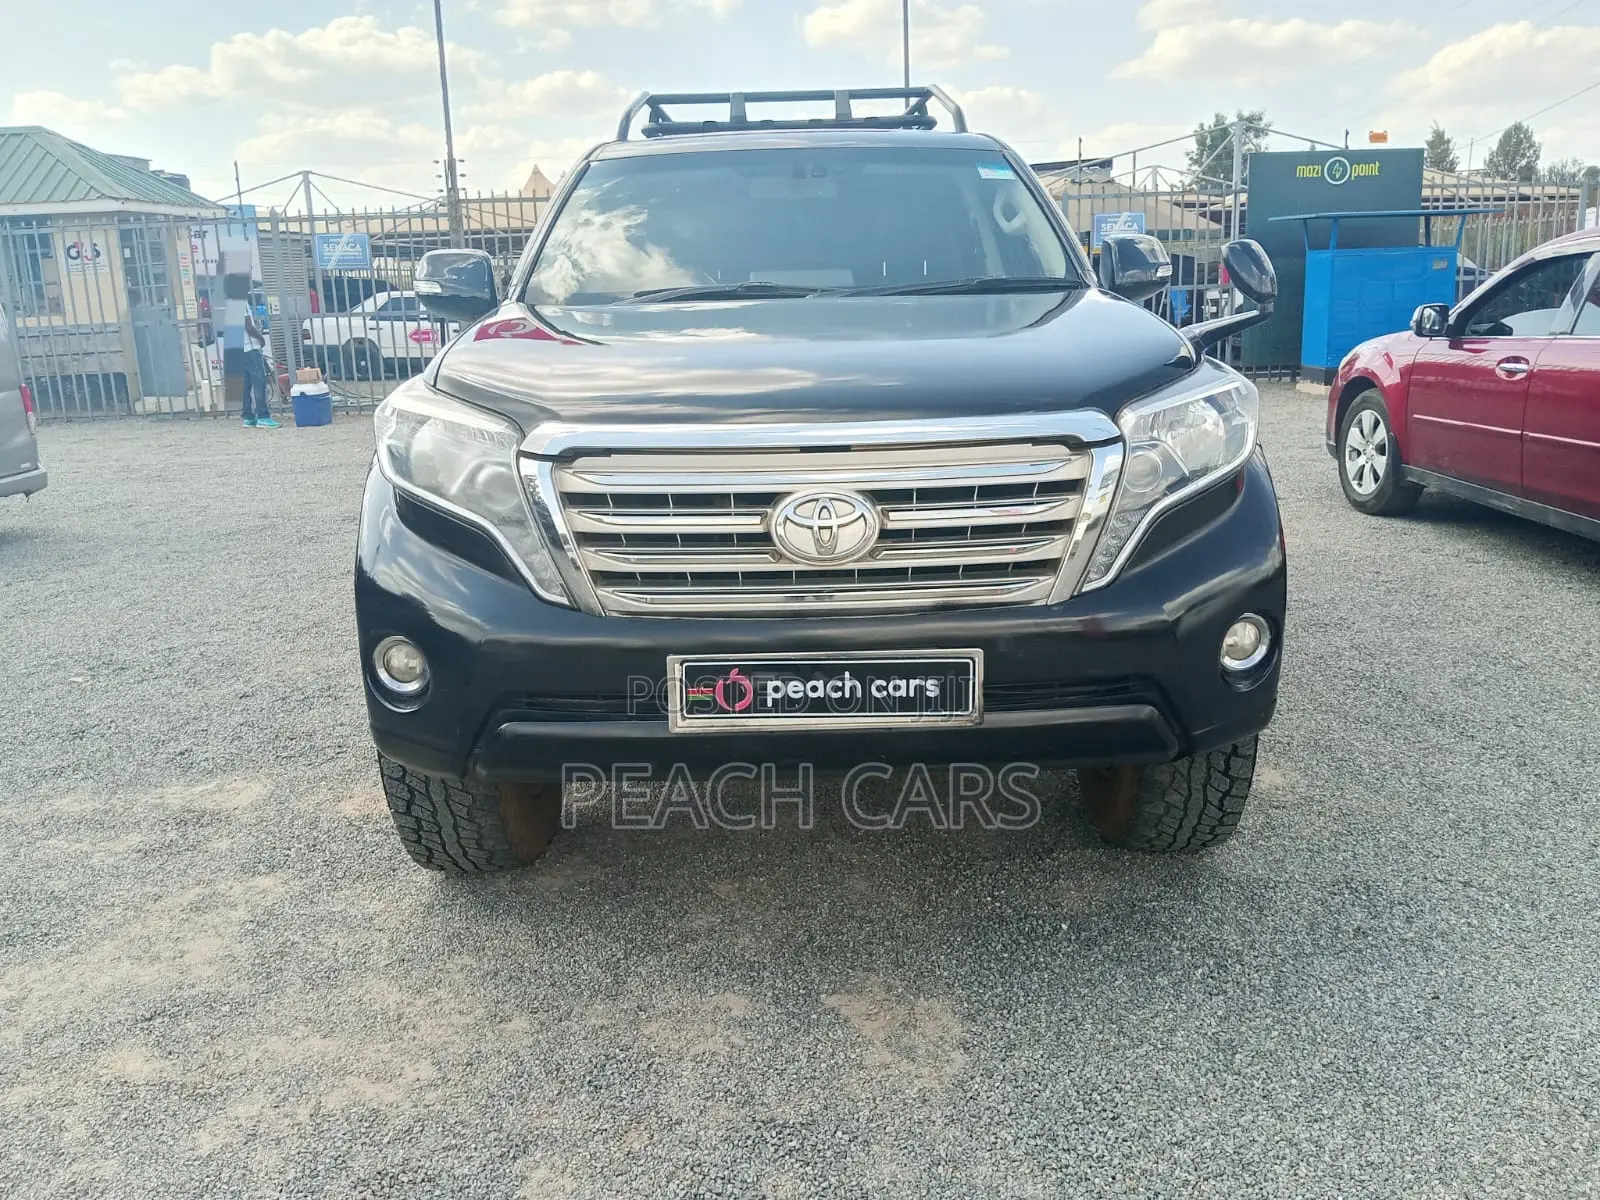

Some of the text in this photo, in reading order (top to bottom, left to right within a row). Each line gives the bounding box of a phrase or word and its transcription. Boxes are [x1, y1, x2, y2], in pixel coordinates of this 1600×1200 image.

[1351, 161, 1380, 180] point
[766, 671, 940, 708] peach cars
